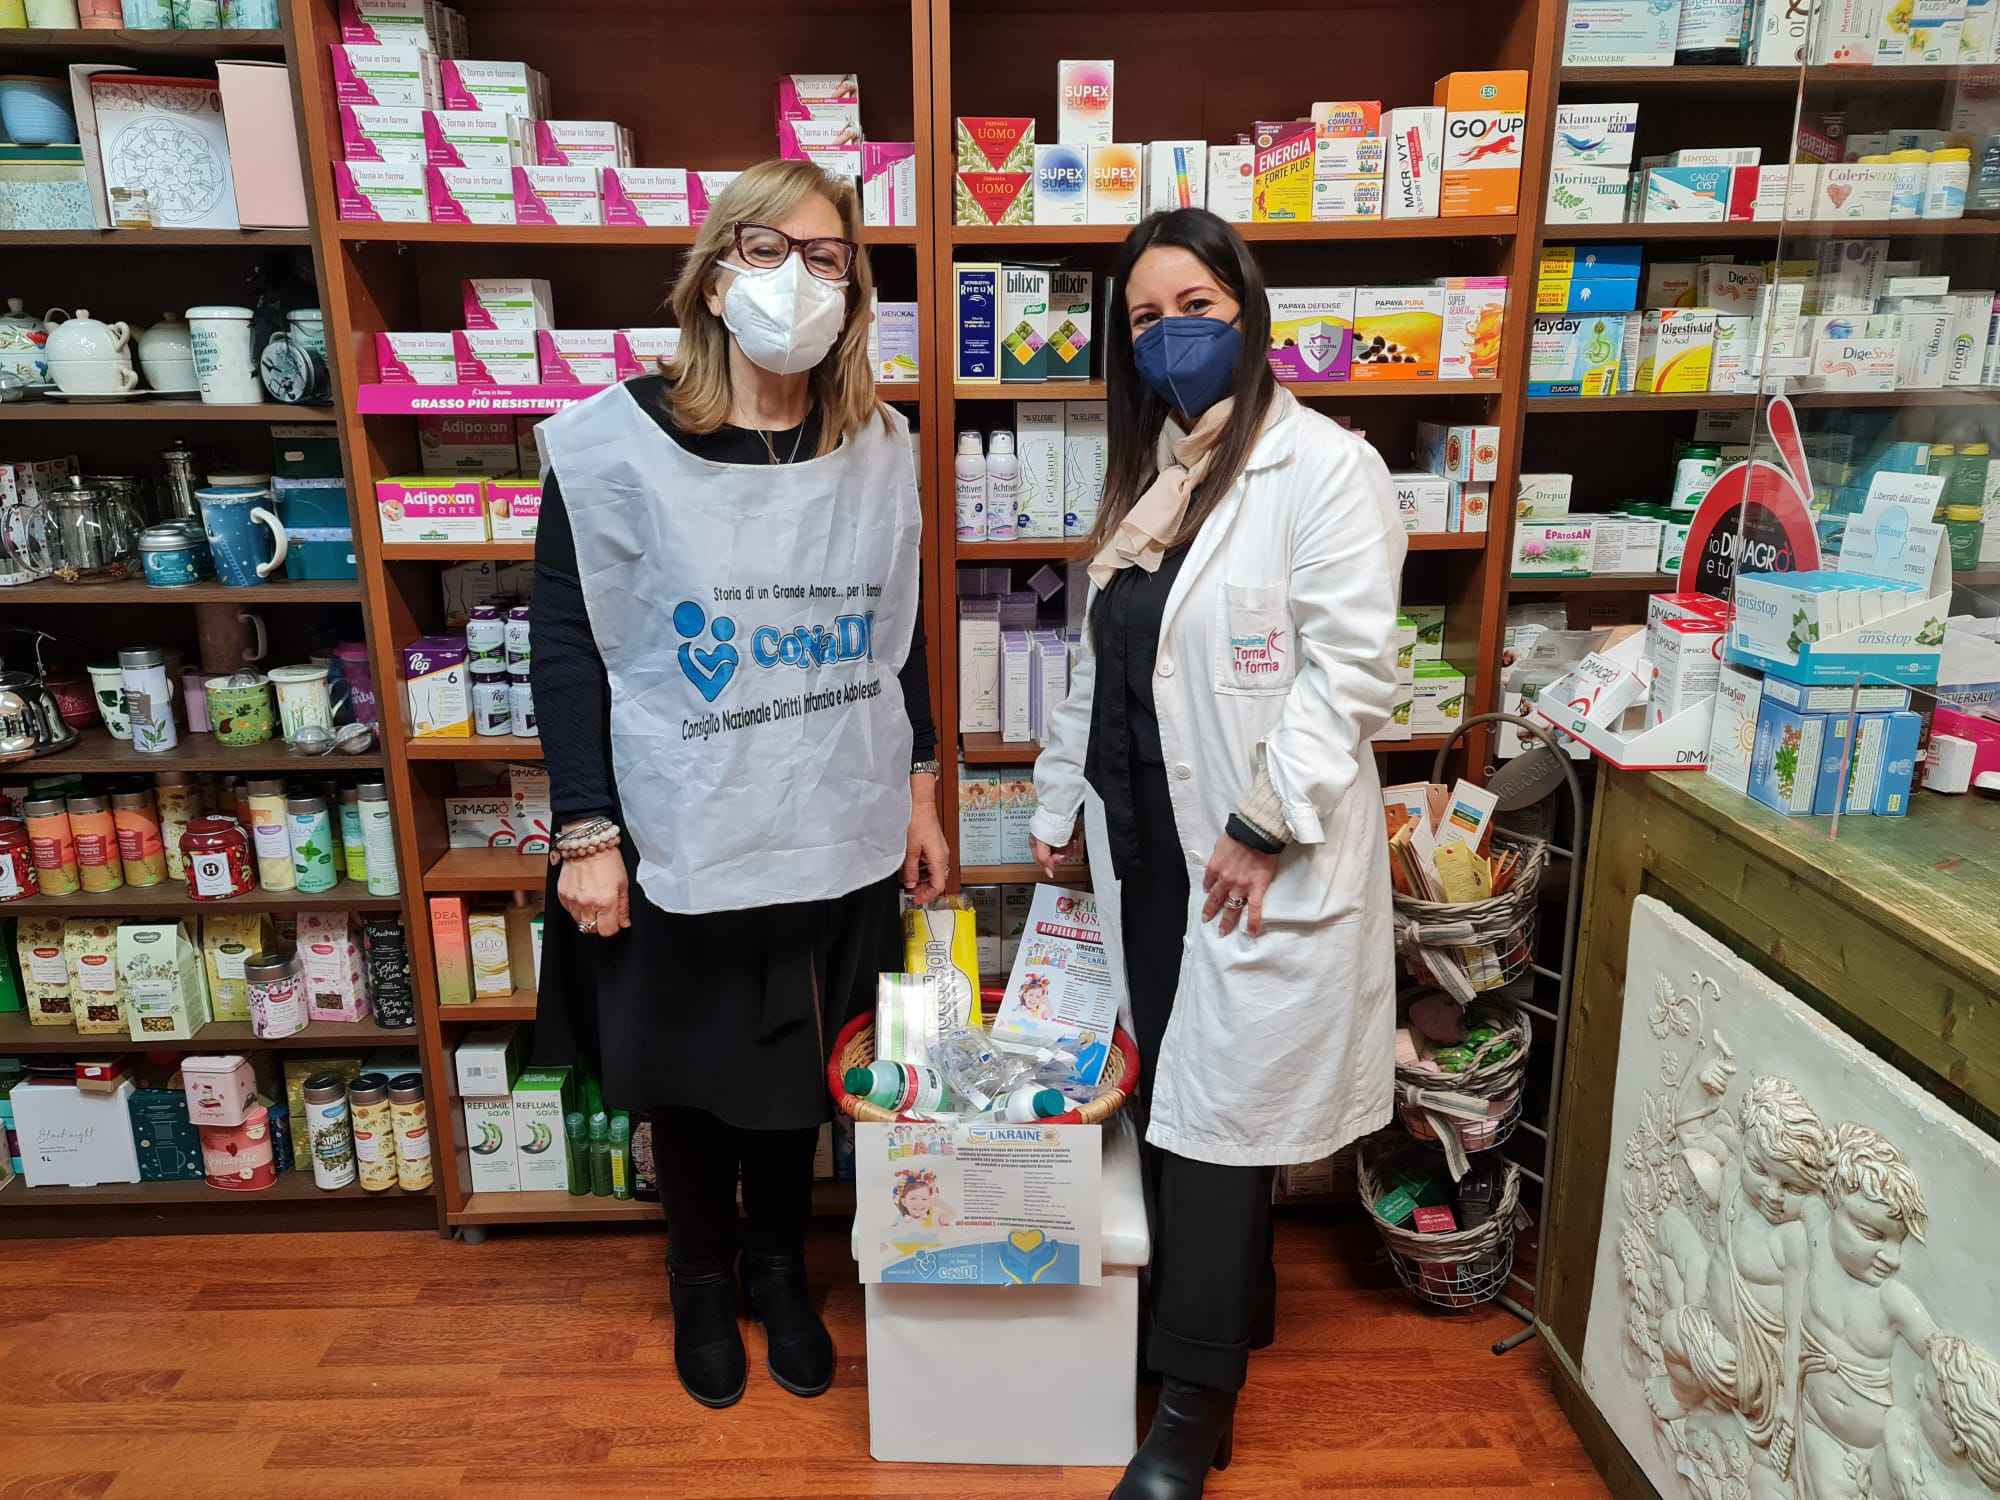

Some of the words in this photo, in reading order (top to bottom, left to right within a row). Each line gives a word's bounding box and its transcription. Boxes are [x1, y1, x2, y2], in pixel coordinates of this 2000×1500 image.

[1065, 86, 1108, 97] SUPEX
[467, 120, 474, 129] in
[1450, 119, 1486, 138] GO
[1498, 118, 1524, 134] UP
[978, 128, 1016, 139] UOMO
[1259, 138, 1312, 172] ENERGIA
[1040, 168, 1082, 180] SUPEX
[1094, 168, 1136, 178] SUPEX
[1265, 167, 1288, 184] FORTE
[1290, 157, 1310, 174] PLUS
[1552, 172, 1606, 185] Moringa
[976, 184, 1014, 194] UOMO
[1696, 181, 1716, 190] CYST
[1007, 272, 1044, 294] bilixir
[1052, 272, 1088, 294] bilixir
[1278, 302, 1306, 310] PAPAYA
[1307, 302, 1342, 310] DEFENSE
[1662, 322, 1712, 336] DigestivAid
[418, 340, 424, 348] in
[496, 338, 502, 347] in
[1662, 338, 1671, 346] No
[1551, 384, 1579, 392] ZUCCARI
[412, 398, 464, 409] GRASSO
[468, 397, 490, 409] PIÙ
[403, 491, 475, 508] Adipoxan
[514, 494, 542, 507] Adip
[429, 506, 476, 514] FORTE
[1706, 560, 1716, 574] e
[714, 586, 742, 601] Storia
[746, 585, 754, 600] di
[758, 587, 769, 599] un
[773, 584, 805, 598] Grande
[809, 584, 844, 598] Amore...
[846, 586, 858, 599] per
[1736, 596, 1778, 617] ansistop
[1857, 632, 1912, 647] ansistop
[1234, 646, 1266, 660] Torna
[409, 652, 430, 674] Pep
[1246, 661, 1280, 674] forma
[448, 672, 458, 684] 6
[1720, 682, 1746, 703] BetaSun
[682, 716, 720, 740] Consiglio
[722, 704, 771, 732] Nazionale
[774, 695, 801, 720] Diritti
[804, 692, 834, 714] Infanzia
[836, 690, 842, 705] e
[511, 769, 546, 778] DIMAGR
[206, 865, 216, 875] H
[434, 911, 458, 920] DEA
[1041, 923, 1076, 938] APPELLO
[467, 1102, 510, 1111] REFLUMIL
[516, 1102, 558, 1110] REFLUMIL
[989, 1128, 1041, 1142] UKRAINE
